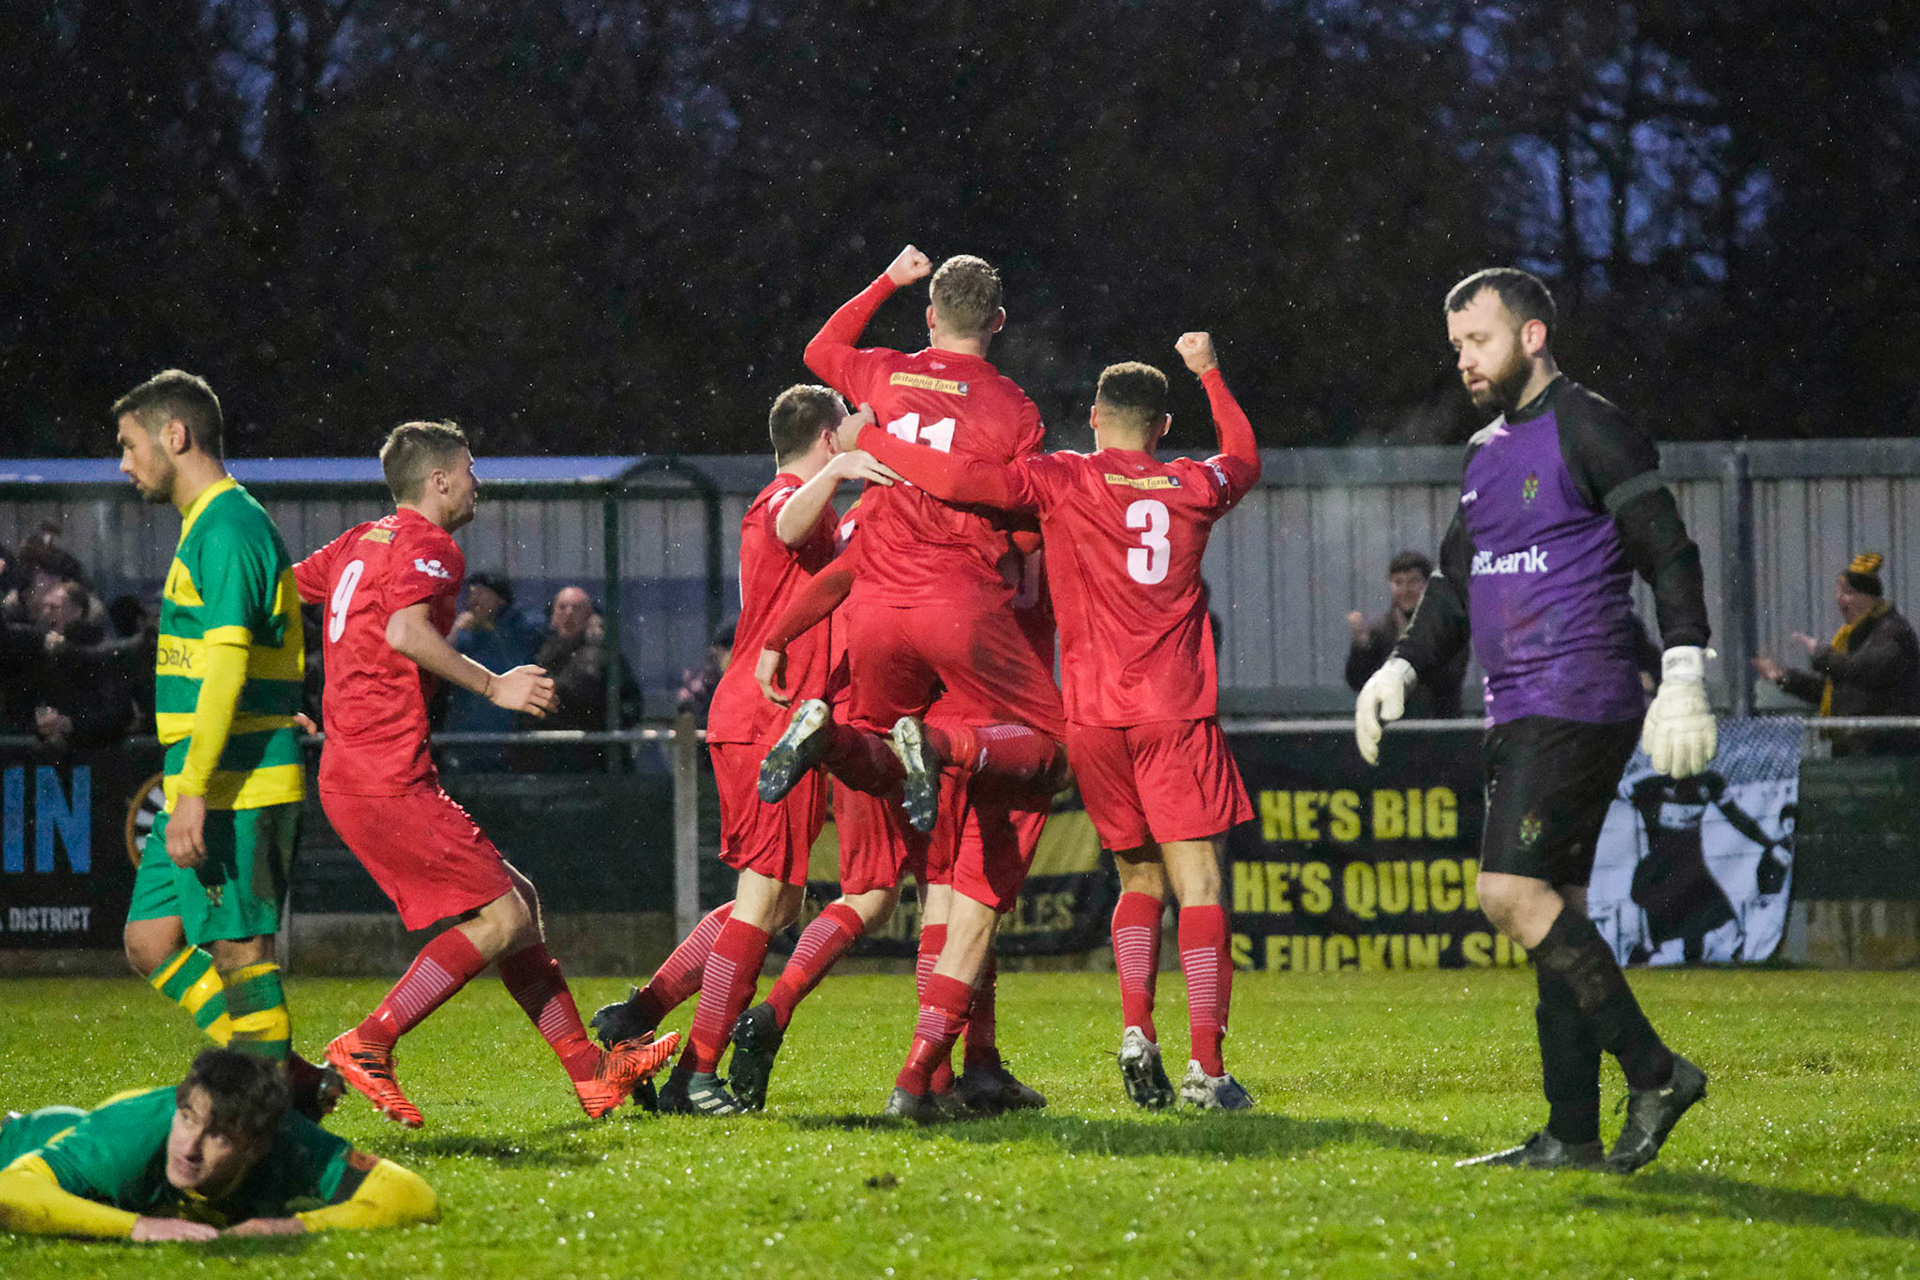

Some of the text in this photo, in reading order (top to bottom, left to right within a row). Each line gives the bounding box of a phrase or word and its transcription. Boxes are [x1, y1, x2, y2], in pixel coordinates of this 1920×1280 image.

[893, 373, 933, 386] Britannia
[934, 380, 957, 390] Taxis
[1126, 499, 1171, 585] 3
[329, 560, 365, 643] 9
[3, 765, 91, 873] IN
[1259, 786, 1458, 842] HE'S BIG
[1232, 861, 1332, 914] HE'S
[9, 906, 91, 932] DISTRICT
